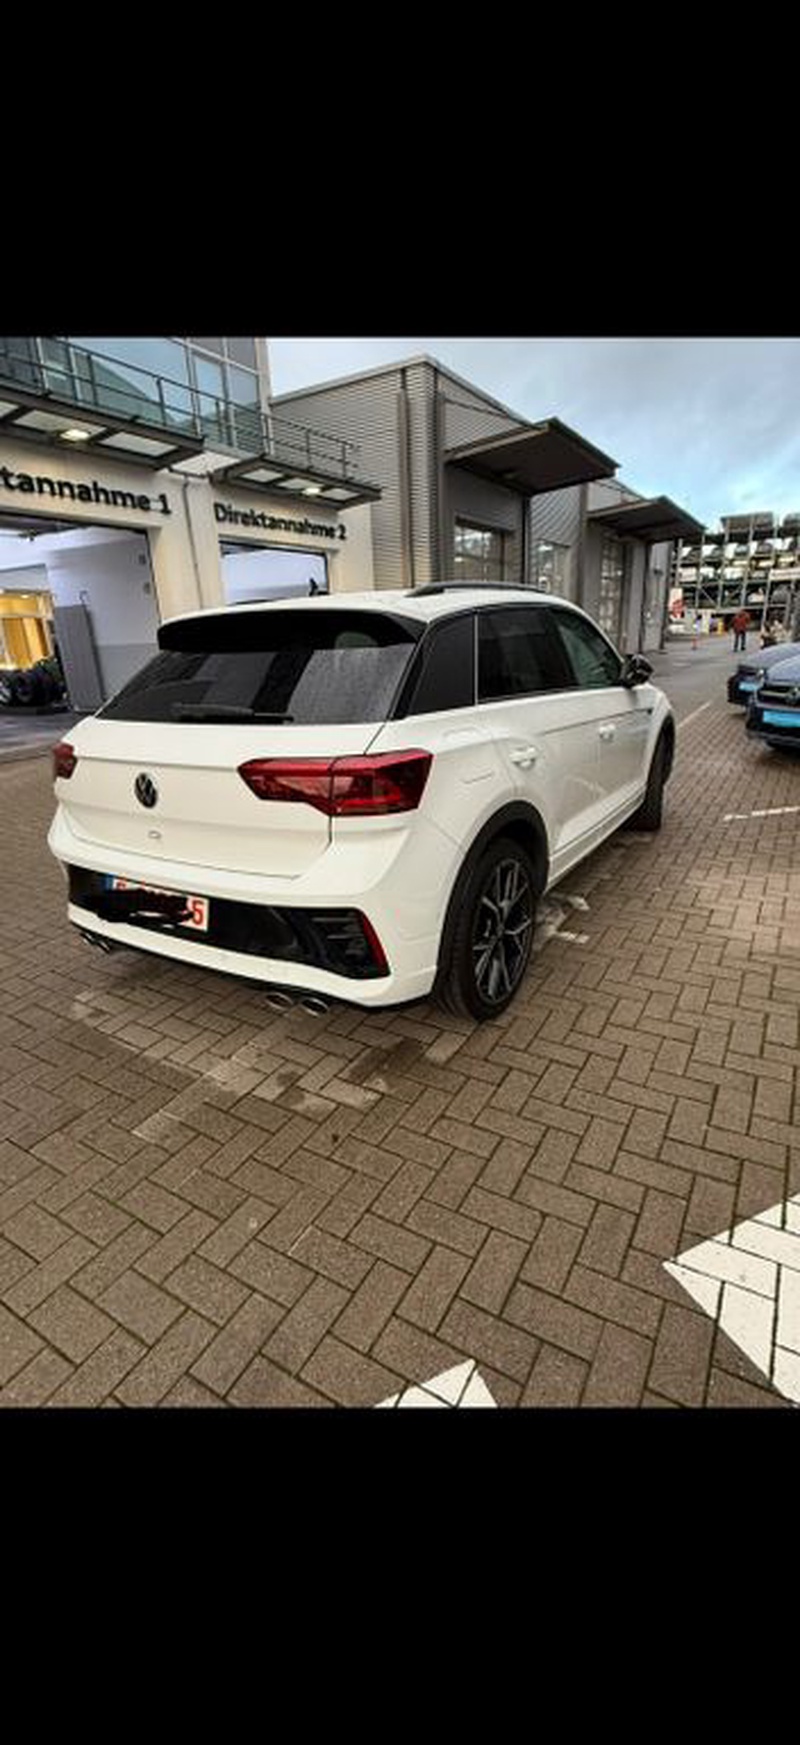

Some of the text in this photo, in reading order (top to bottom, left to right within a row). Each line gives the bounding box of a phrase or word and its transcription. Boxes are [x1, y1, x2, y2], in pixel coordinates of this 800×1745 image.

[159, 493, 172, 516] 1
[214, 502, 347, 541] Direktannahme 2
